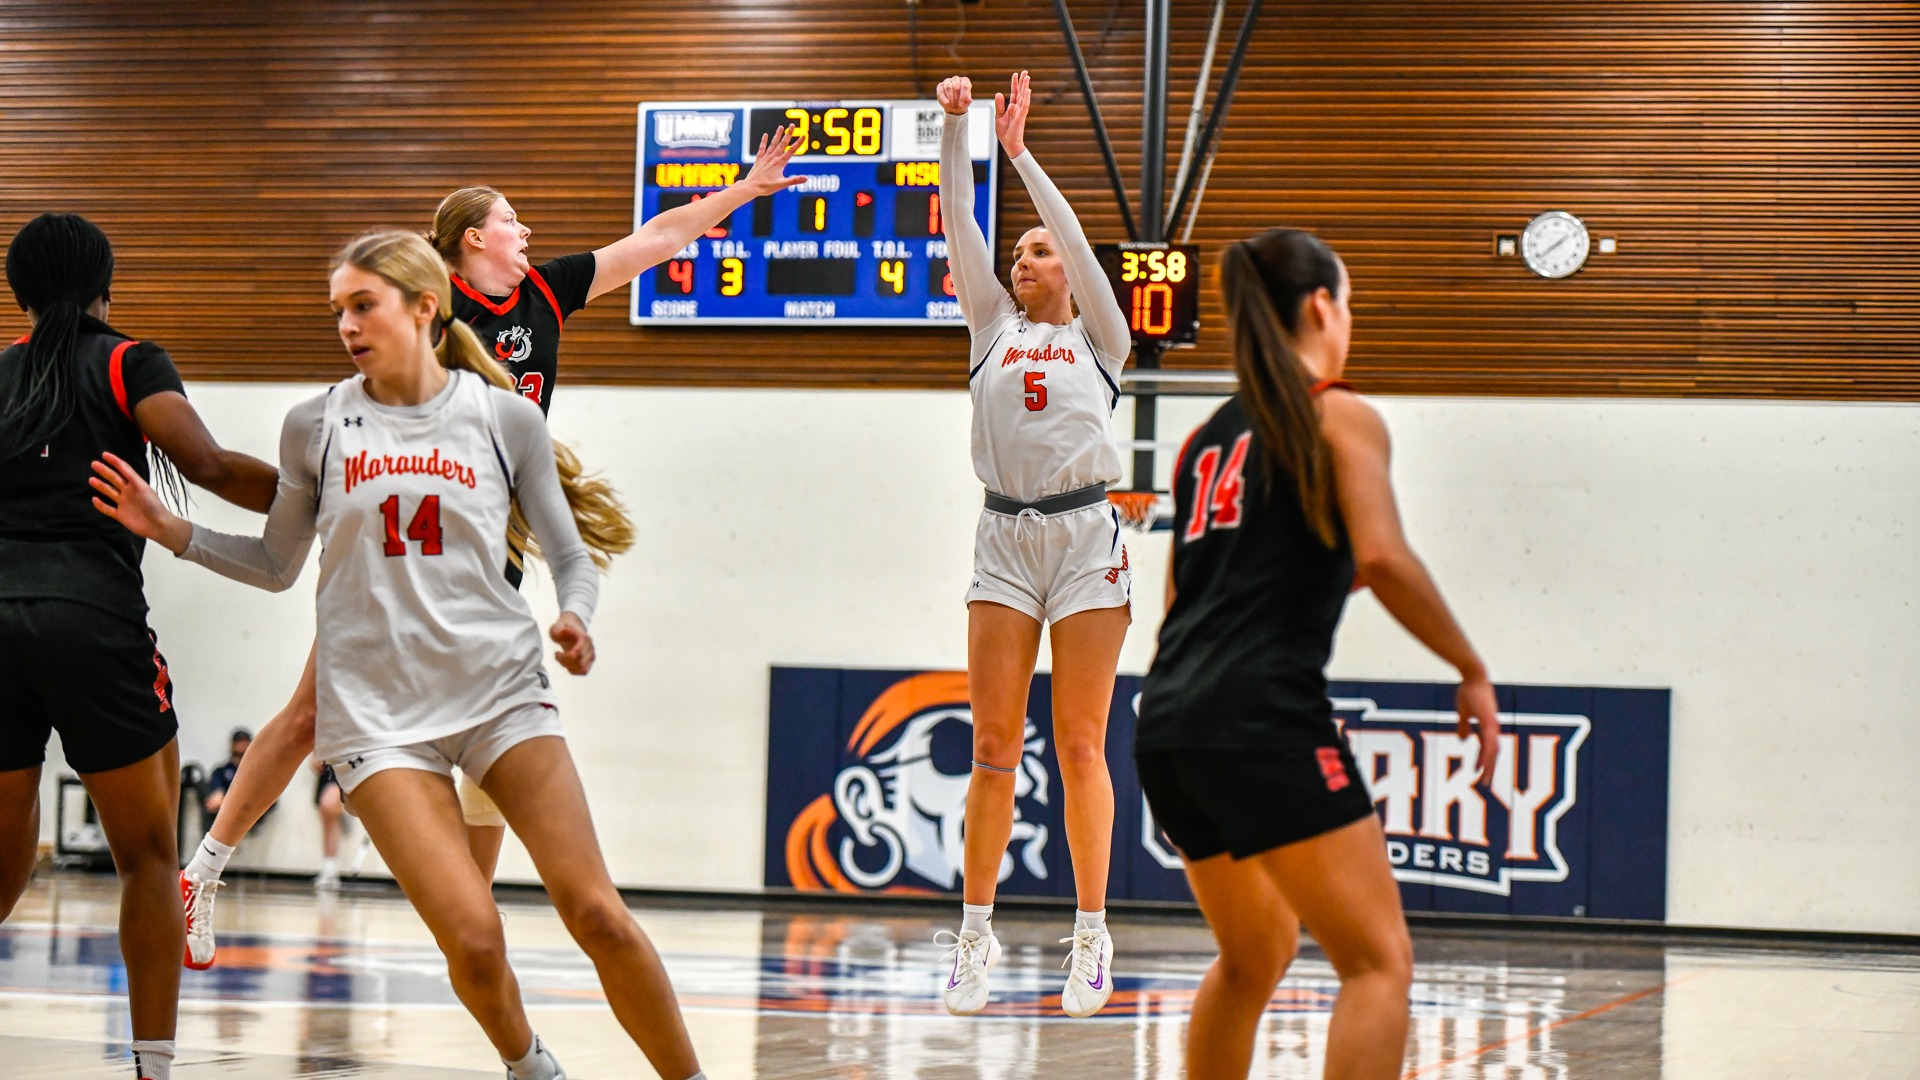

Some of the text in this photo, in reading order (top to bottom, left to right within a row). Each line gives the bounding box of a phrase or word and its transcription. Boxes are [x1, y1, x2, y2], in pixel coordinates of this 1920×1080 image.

[785, 108, 881, 155] 3:58
[656, 163, 739, 187] UMARY
[814, 198, 826, 231] 1
[763, 240, 861, 259] PLAYER FOUL
[1121, 251, 1186, 282] 3:58
[668, 260, 693, 294] 4
[721, 258, 744, 296] 3
[880, 260, 905, 294] 4
[651, 300, 698, 318] SCORE
[1132, 283, 1173, 335] 10
[508, 371, 544, 405] 3
[1023, 371, 1048, 411] 5
[345, 448, 475, 495] Marauders
[1183, 430, 1252, 543] 14
[379, 494, 444, 558] 14
[1335, 718, 1561, 862] ARY
